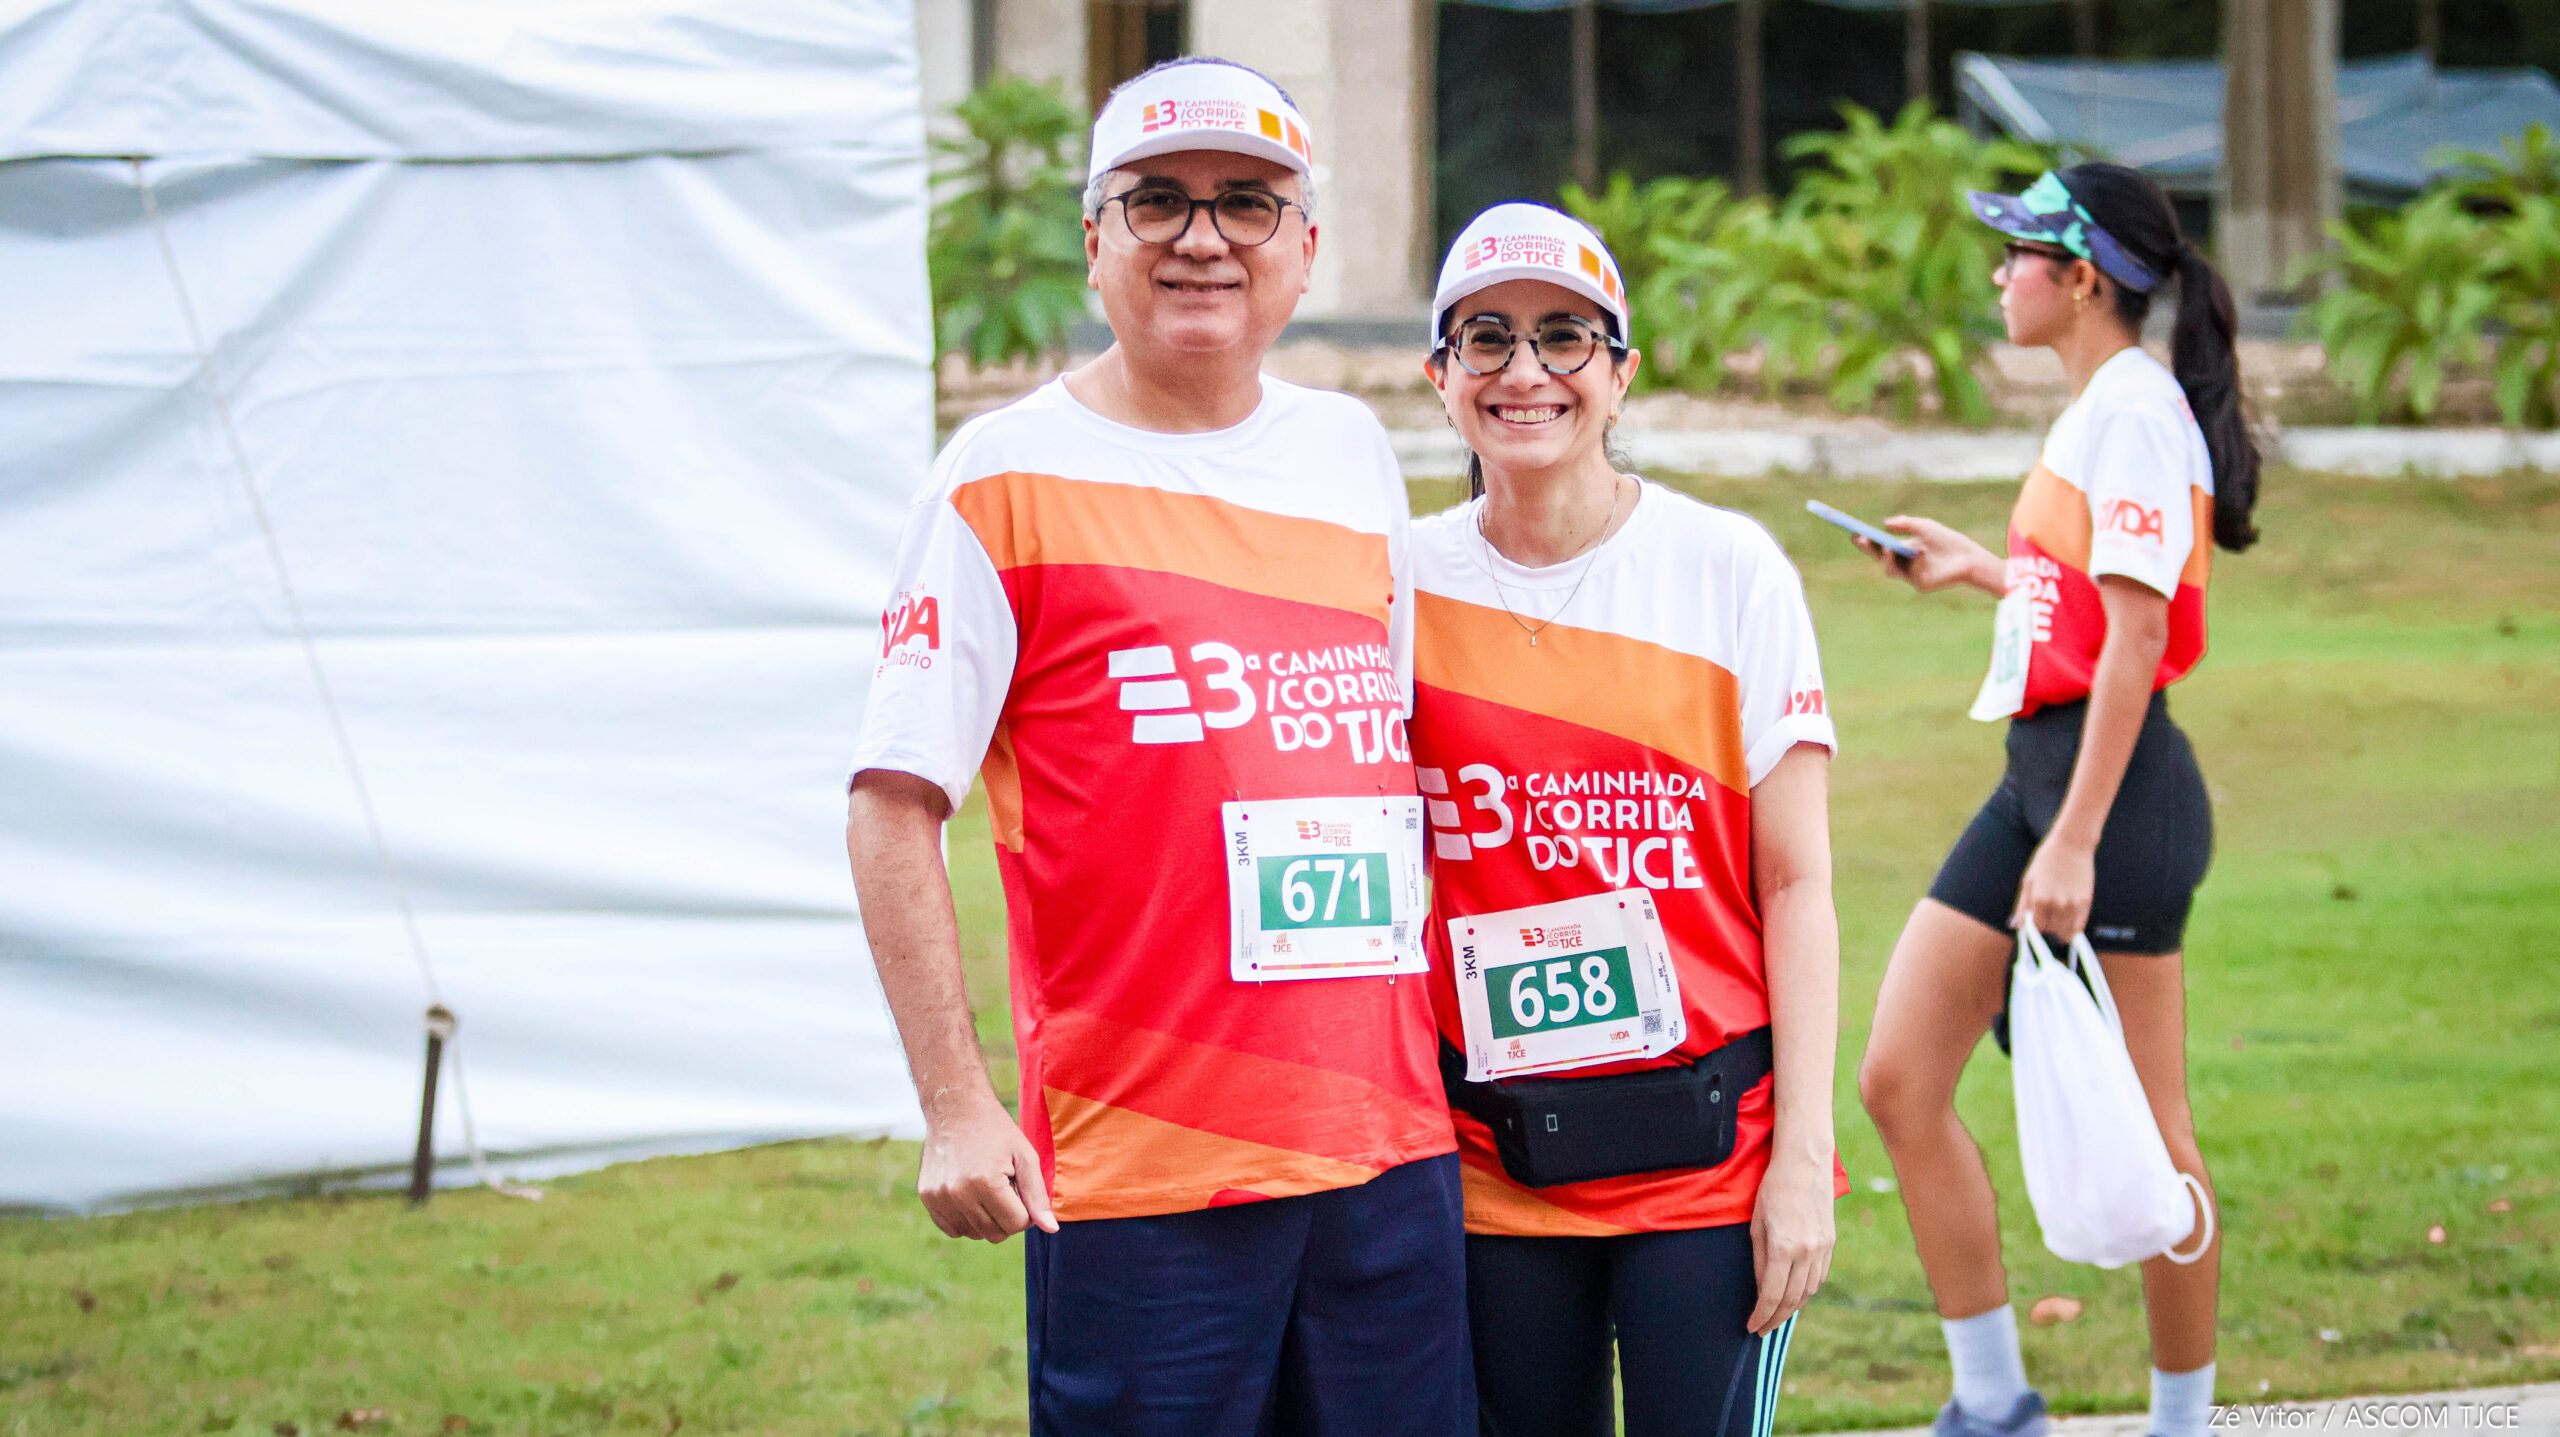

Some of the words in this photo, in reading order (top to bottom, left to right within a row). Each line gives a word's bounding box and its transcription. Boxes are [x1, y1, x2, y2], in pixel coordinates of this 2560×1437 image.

[1185, 100, 1247, 110] CAMINHADA
[1504, 234, 1566, 246] CAMINHADA
[1501, 251, 1521, 262] DO
[1523, 251, 1564, 268] TJCE
[1270, 712, 1333, 751] DO
[1525, 770, 1706, 801] CAMINHADA
[1523, 799, 1695, 833] /CORRIDA
[1235, 831, 1250, 866] 3KM
[1333, 835, 1352, 847] TJCE
[1525, 834, 1579, 871] DO
[1580, 836, 1704, 890] TJCE
[1281, 858, 1371, 923] 671
[1272, 943, 1292, 953] TJCE
[1547, 940, 1559, 948] DO
[1559, 936, 1583, 949] TJCE
[1462, 945, 1478, 980] 3KM
[1509, 955, 1617, 1028] 658
[1507, 1049, 1526, 1060] TJCE
